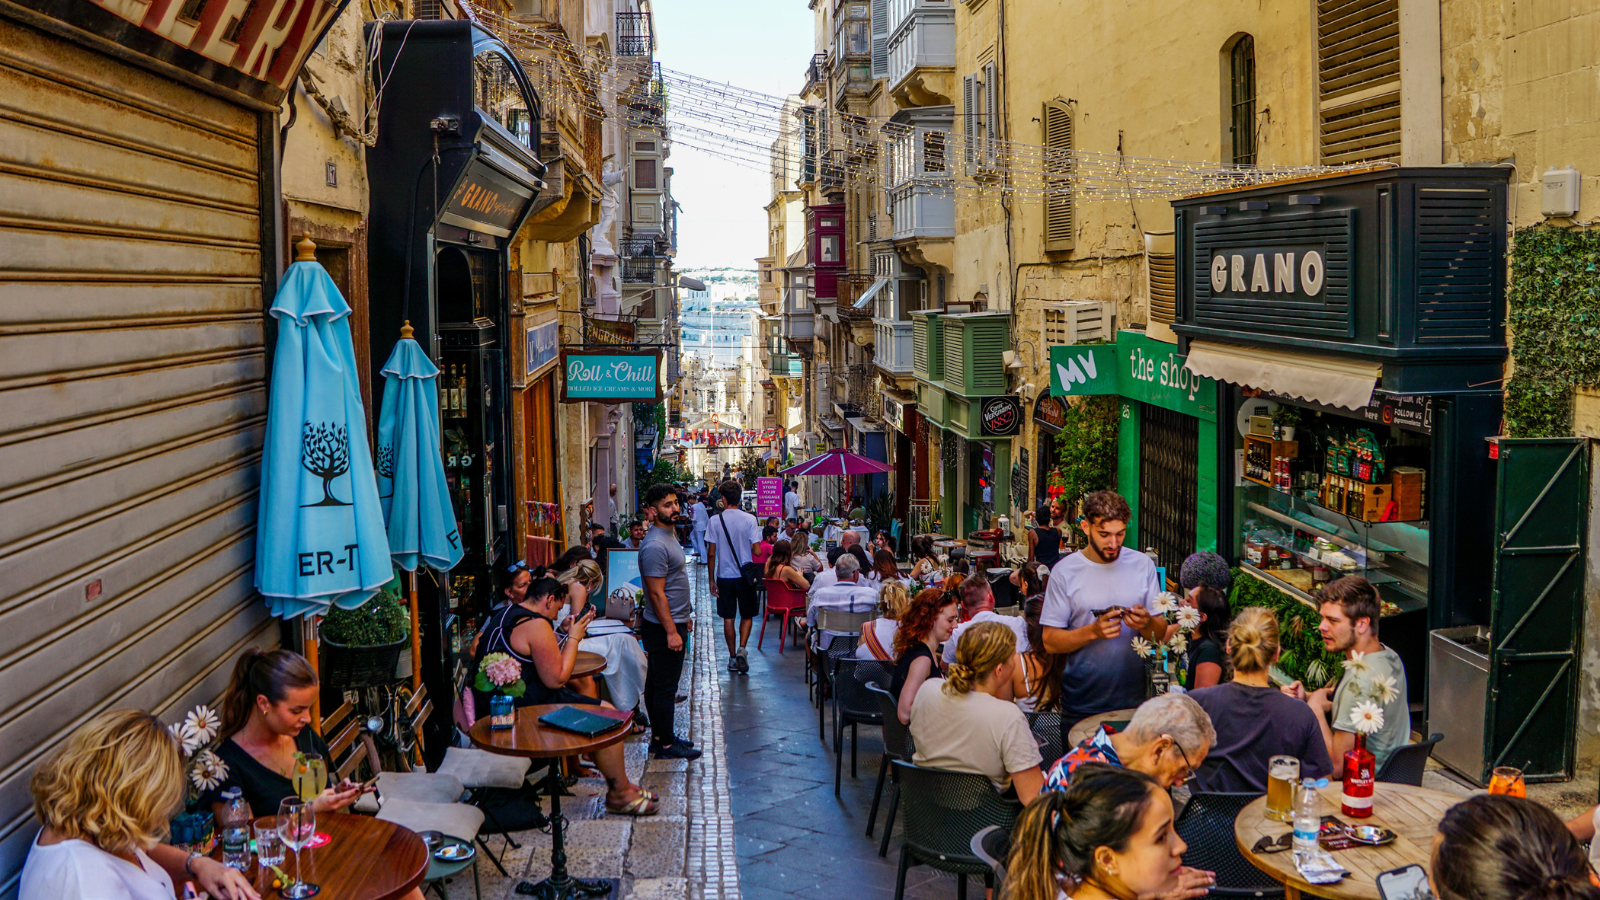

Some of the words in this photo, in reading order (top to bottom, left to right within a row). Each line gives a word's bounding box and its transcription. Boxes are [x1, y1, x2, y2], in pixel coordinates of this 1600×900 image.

[461, 183, 498, 214] GRANO
[1211, 250, 1324, 297] GRANO
[568, 360, 604, 381] Roll
[605, 369, 612, 378] &
[610, 361, 655, 382] Chill
[1056, 349, 1097, 391] MV
[1130, 347, 1154, 382] the
[1160, 352, 1200, 401] shop
[991, 411, 1013, 431] 1882
[1122, 404, 1130, 419] 25
[1365, 408, 1378, 420] here
[1394, 408, 1414, 418] FOLLOW
[1415, 411, 1423, 420] US
